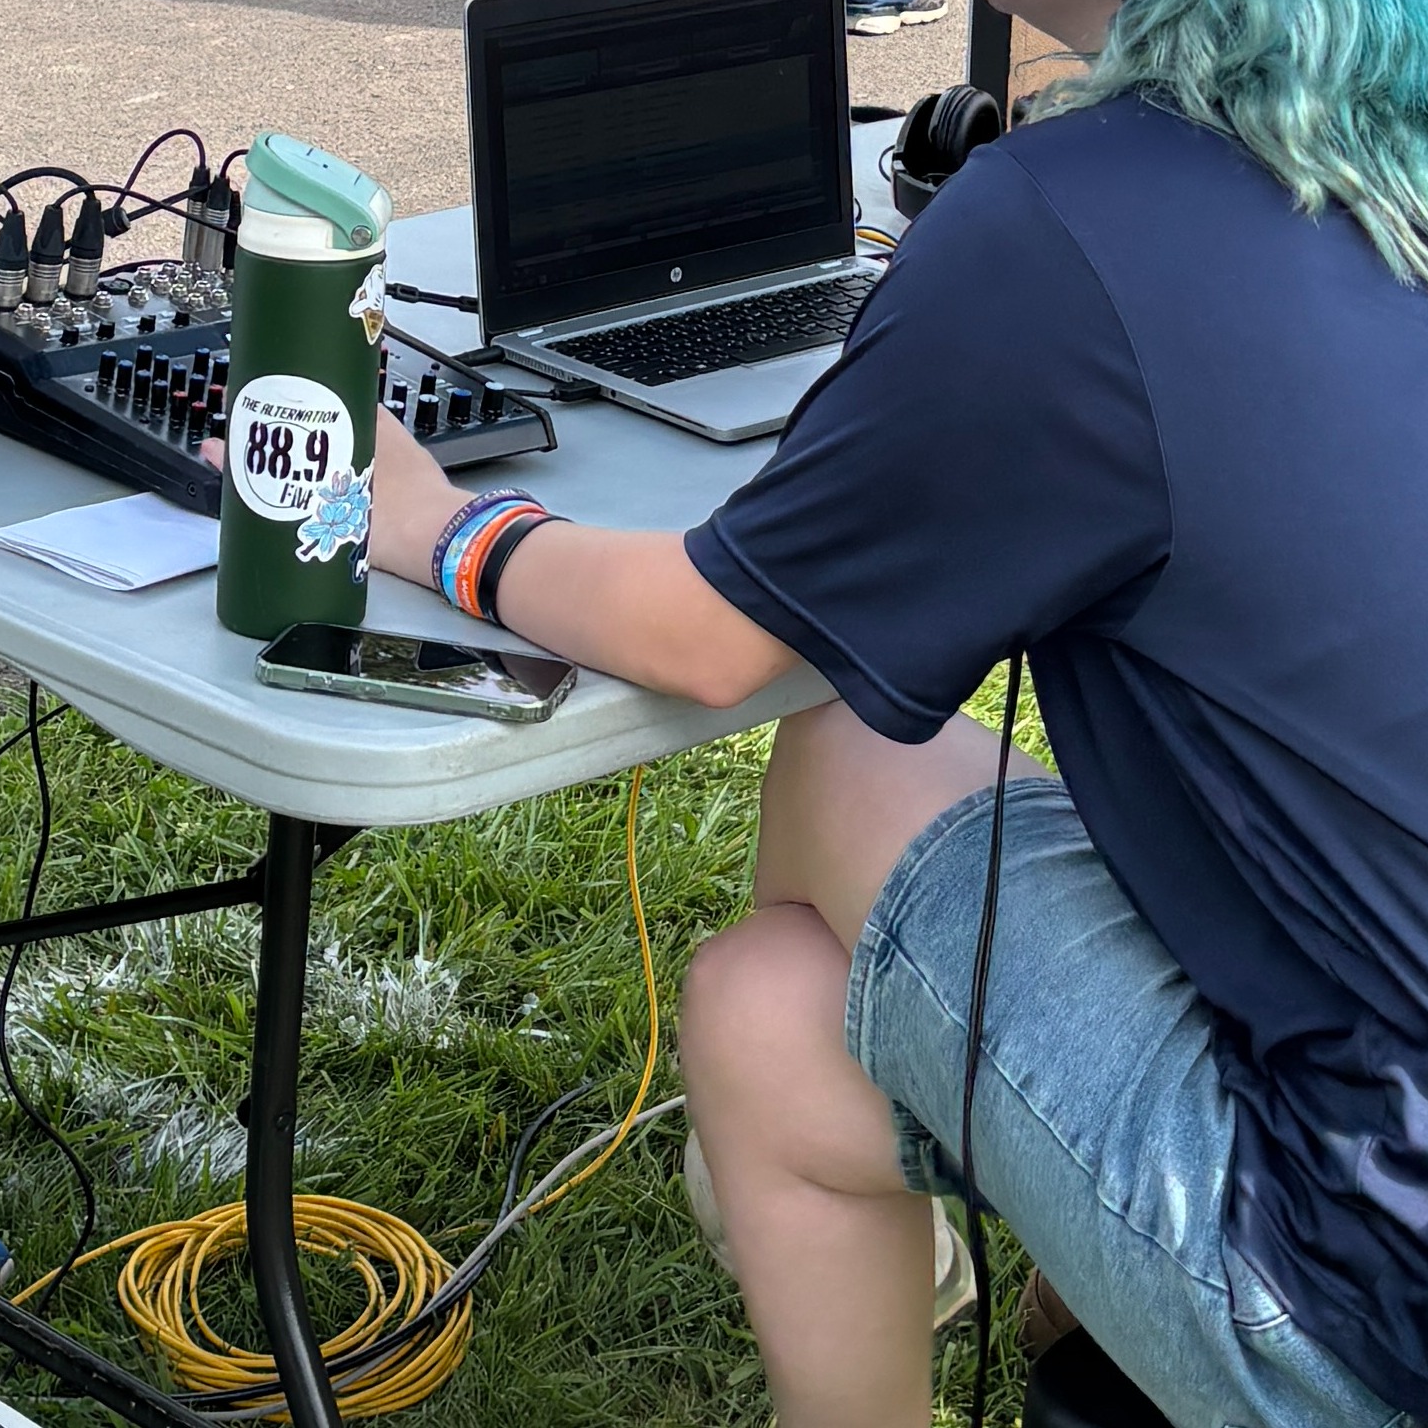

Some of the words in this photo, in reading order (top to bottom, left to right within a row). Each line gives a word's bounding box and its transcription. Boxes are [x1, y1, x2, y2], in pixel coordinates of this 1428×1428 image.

[241, 395, 258, 412] THE
[260, 404, 340, 423] ALTERNATION
[247, 420, 329, 482] 88.9
